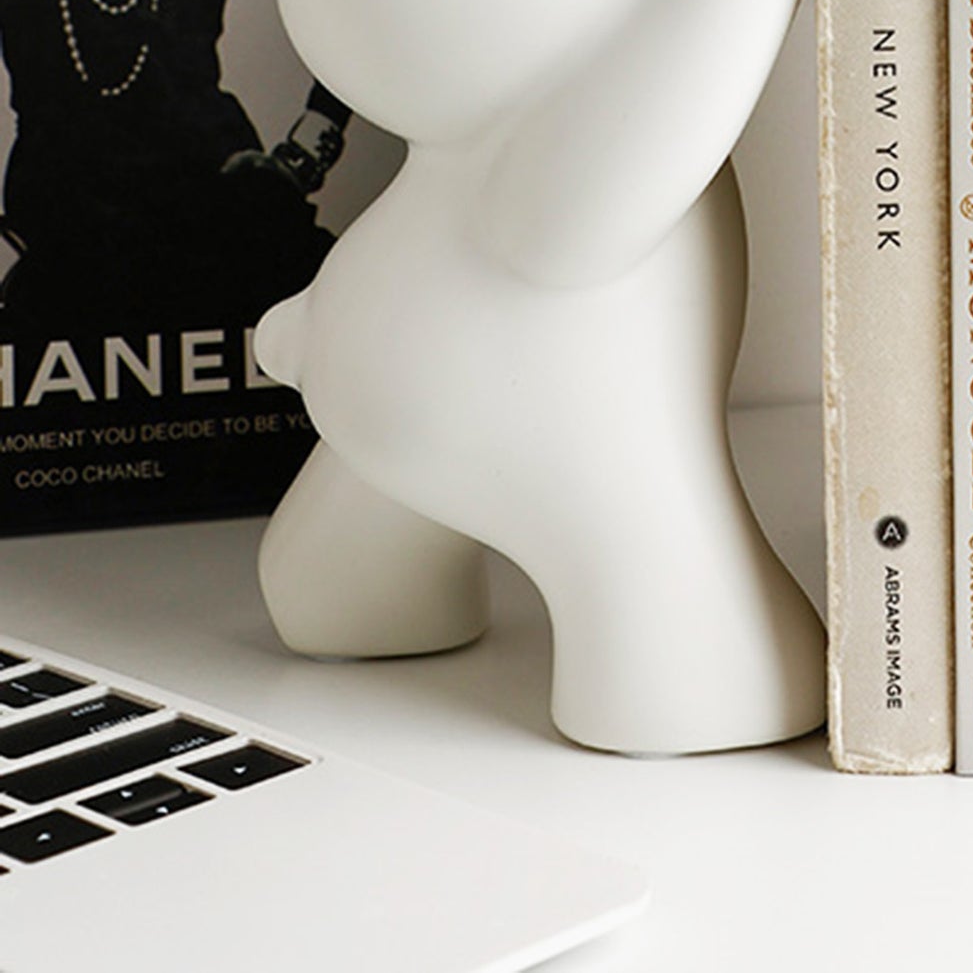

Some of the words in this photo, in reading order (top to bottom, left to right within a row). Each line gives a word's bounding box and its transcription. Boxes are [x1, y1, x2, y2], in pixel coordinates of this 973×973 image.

[873, 30, 896, 118] NEW
[876, 142, 900, 249] YORK
[0, 328, 287, 407] ANEL
[93, 425, 136, 445] YOU
[141, 420, 216, 441] DECIDE
[221, 416, 250, 434] TO
[255, 414, 280, 431] BE
[14, 467, 77, 489] COCO
[82, 460, 165, 481] CHANEL
[885, 567, 900, 645] ABRAMS
[887, 651, 902, 708] IMAGE
